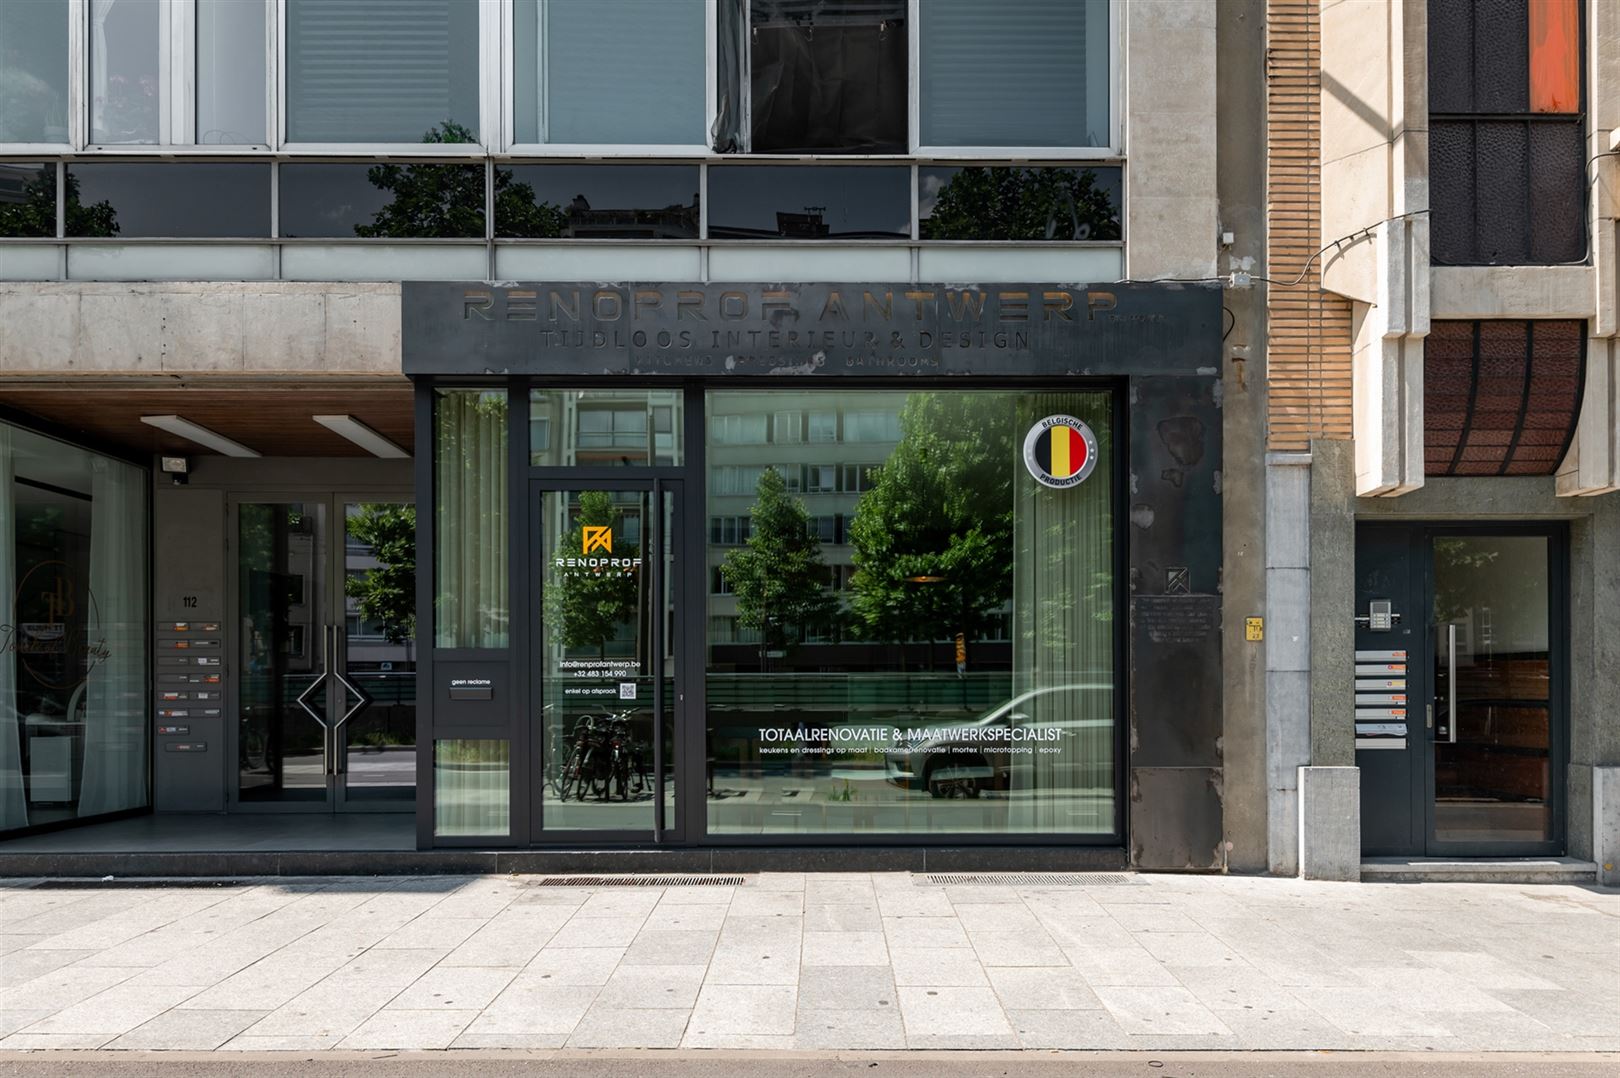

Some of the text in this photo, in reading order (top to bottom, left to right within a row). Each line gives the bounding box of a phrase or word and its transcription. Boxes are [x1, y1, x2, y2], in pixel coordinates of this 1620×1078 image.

[463, 290, 1118, 321] RENOPROF ANTWERP
[540, 330, 1030, 349] TIJDLOOS INTERIEUR & DESIGN
[845, 356, 939, 367] BATHROOMS
[1042, 418, 1083, 430] BELGISCHE
[1040, 473, 1082, 485] PRODUCTIE
[555, 558, 643, 567] RENOPROF
[183, 596, 197, 608] 112
[759, 728, 1062, 741] TOTAALRENOVATIE & MAATWERKSPECIALIST
[759, 746, 789, 754] keukens
[801, 746, 834, 755] dressings
[836, 747, 847, 755] op
[848, 746, 868, 754] maat
[874, 746, 946, 754] badkameenovatie
[952, 746, 978, 754] mortex
[984, 746, 1033, 755] microtopping
[1039, 747, 1062, 755] epoxy
